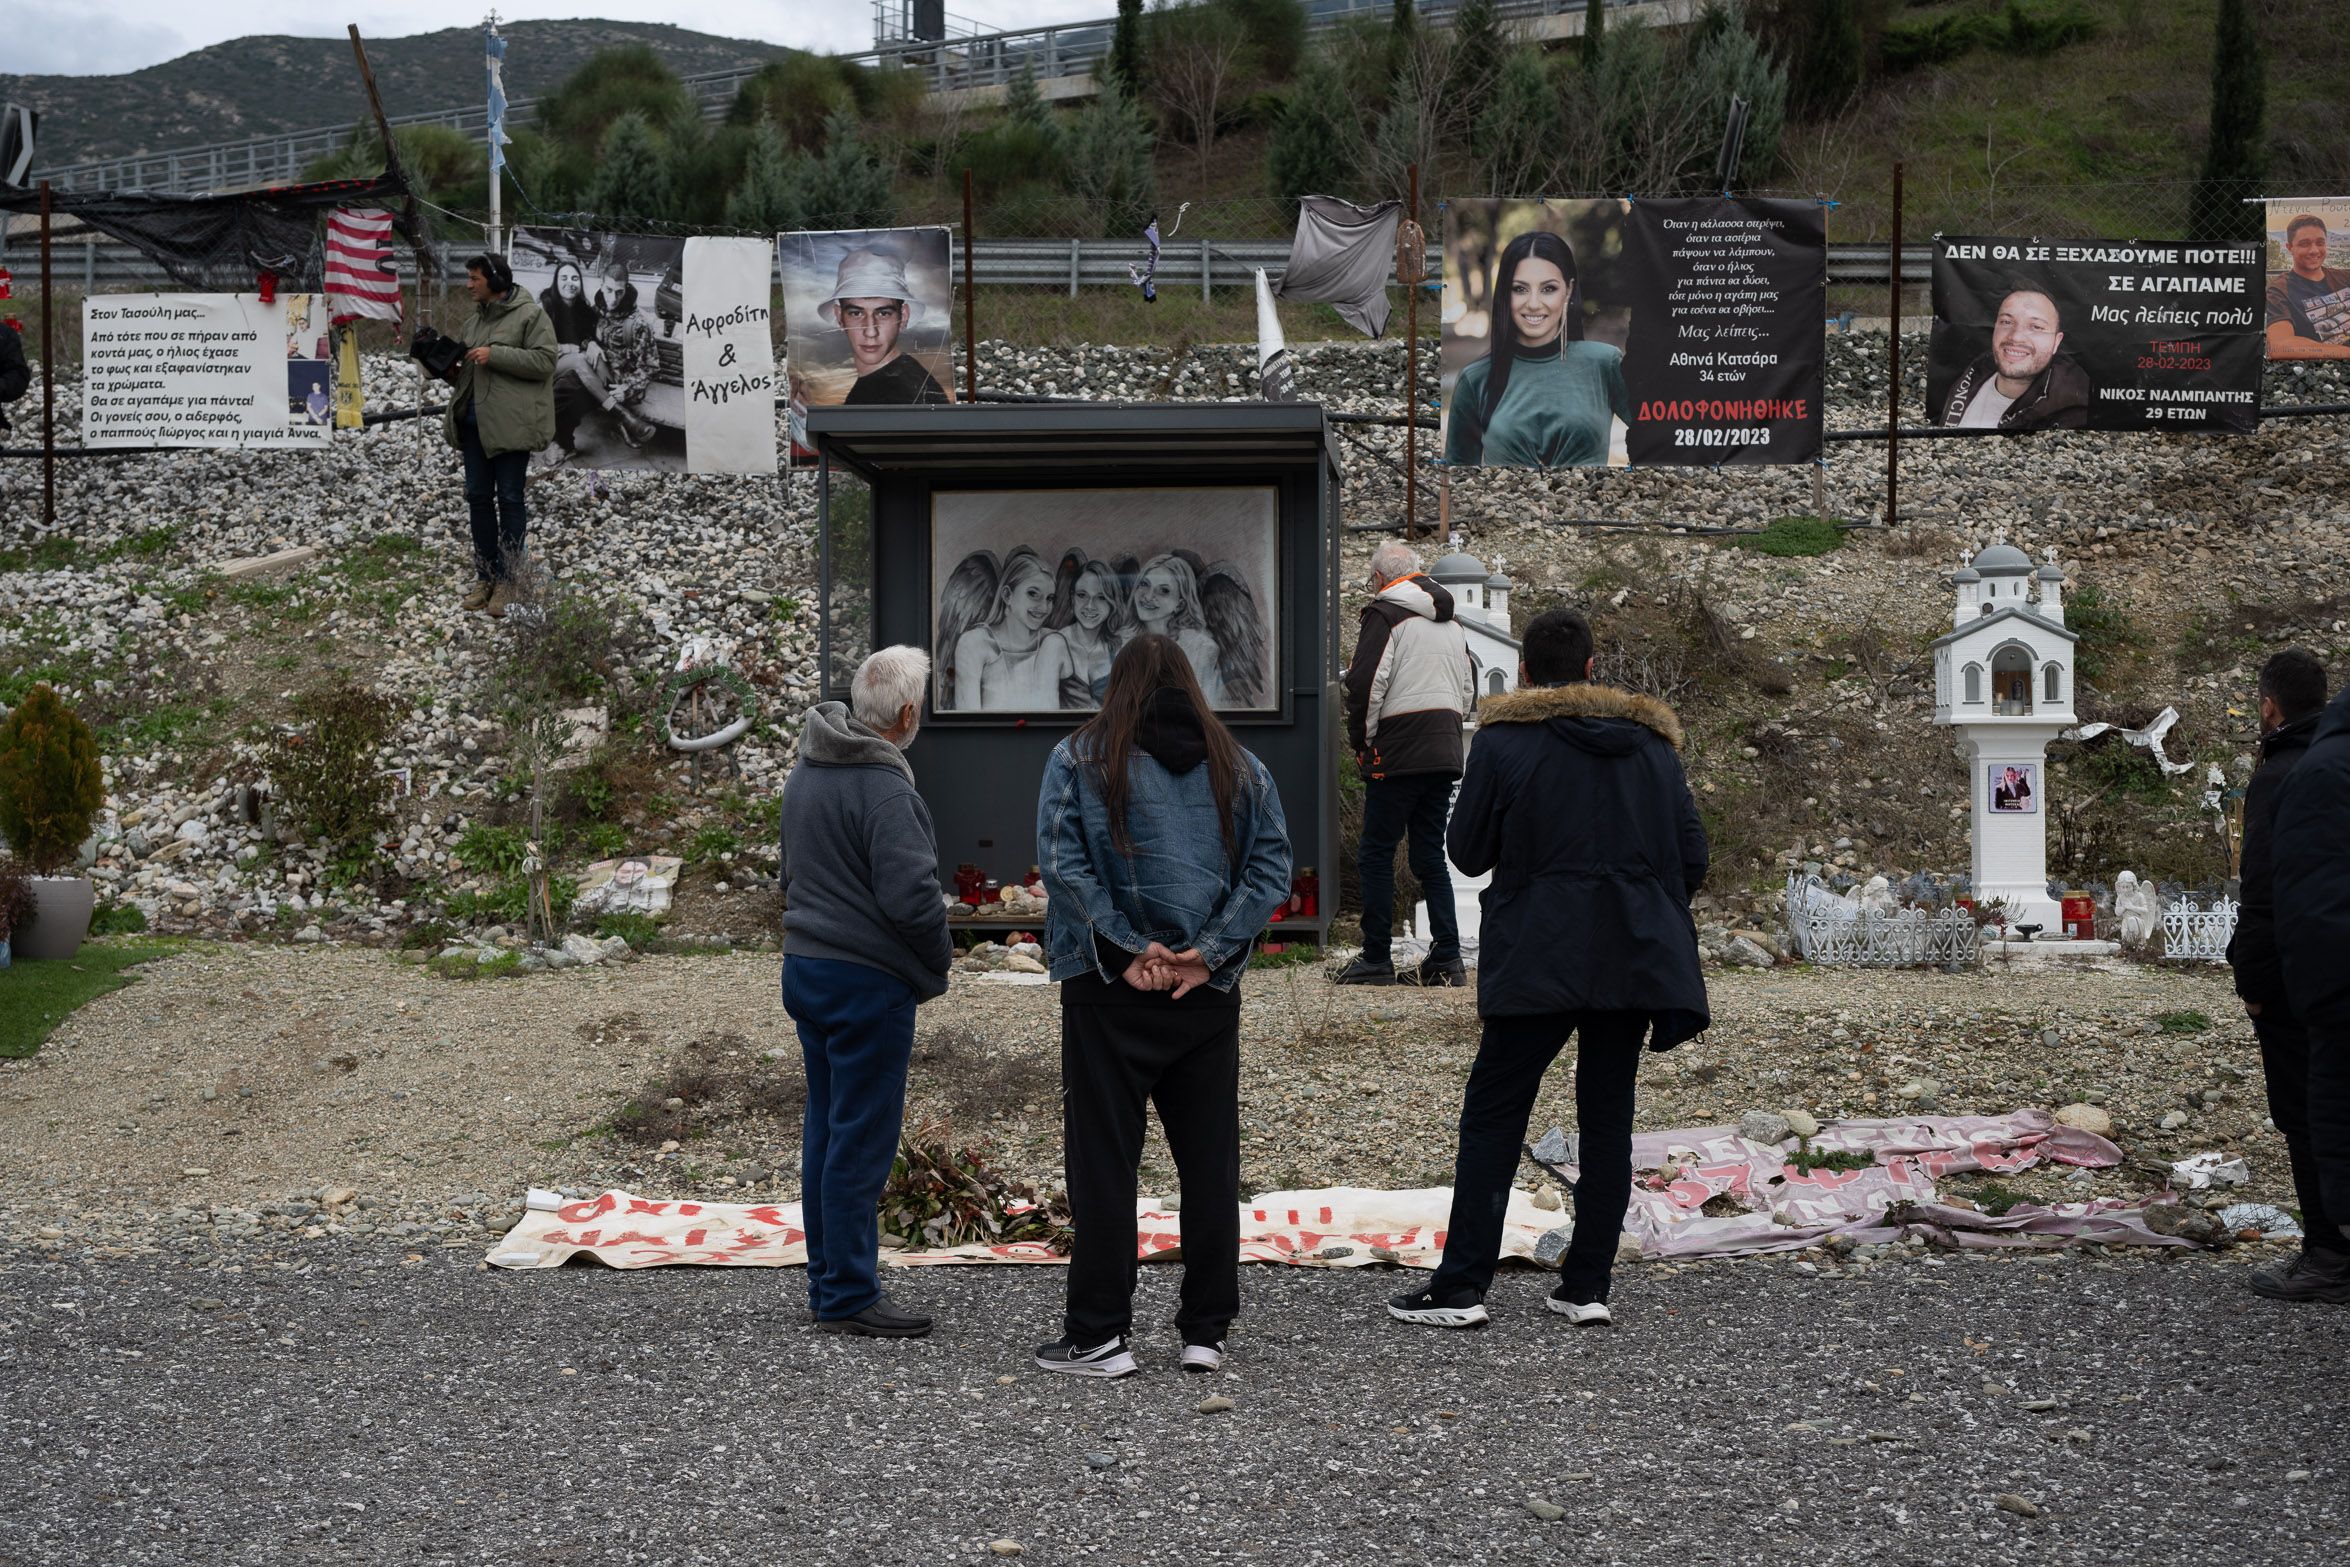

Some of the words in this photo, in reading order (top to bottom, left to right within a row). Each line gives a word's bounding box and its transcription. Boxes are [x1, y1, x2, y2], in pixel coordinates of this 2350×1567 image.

[1664, 219, 1689, 228] Όταν
[1692, 222, 1698, 231] η
[1700, 219, 1744, 228] θάλασσα
[1686, 233, 1709, 242] όταν
[1725, 232, 1761, 244] αστέρια
[1673, 248, 1711, 259] πάψουν
[1729, 247, 1774, 258] λάμπουν,
[1945, 245, 1985, 259] ΔΕΝ
[1993, 246, 2020, 260] ΘΑ
[2026, 247, 2050, 260] ΣΕ
[2056, 248, 2178, 263] ΞΕΧΑΣΟΥΜΕ
[2185, 250, 2255, 264] ΠΟΤΕ!!!
[1693, 262, 1716, 271] όταν
[1727, 261, 1754, 273] ήλιος
[1678, 279, 1693, 288] για
[1697, 276, 1725, 285] πάντα
[1743, 275, 1769, 285] δύσει,
[2109, 276, 2134, 291] ΣΕ
[2141, 277, 2245, 293] ΑΓΑΠΑΜΕ
[1669, 291, 1686, 300] τότε
[1688, 290, 1713, 302] μόνο
[1715, 293, 1721, 302] η
[1724, 290, 1757, 302] αγάπη
[1759, 292, 1779, 301] μας
[91, 309, 117, 319] Στον
[121, 306, 171, 320] Τασούλη
[174, 310, 205, 320] μας...
[1672, 308, 1687, 317] για
[1690, 305, 1716, 314] εσένα
[2091, 305, 2129, 325] Μας
[2135, 306, 2200, 326] λείπεις
[2206, 308, 2252, 324] πολύ
[687, 305, 769, 338] Αφροδίτη
[91, 332, 113, 342] Από
[117, 331, 141, 341] τότε
[145, 332, 167, 340] που
[189, 330, 228, 343] πήραν
[232, 331, 257, 341] από
[1678, 325, 1710, 341] Μας
[1715, 324, 1769, 340] λείπεις...
[91, 348, 125, 358] κοντά
[128, 349, 153, 360] μας,
[167, 346, 199, 359] ήλιος
[203, 347, 238, 359] έχασε
[2150, 340, 2200, 353] ΤΕΜΠΗ
[719, 344, 736, 367] &
[1670, 352, 1713, 365] Αθηνά
[1718, 352, 1777, 367] Κατσάρα
[2138, 354, 2211, 370] 28-02-2023
[107, 366, 131, 376] φως
[134, 365, 152, 373] και
[155, 362, 251, 375] εξαφανίστηκαν
[1700, 370, 1714, 381] 34
[1718, 370, 1746, 381] ετών
[108, 381, 165, 392] χρώματα.
[691, 374, 771, 404] Άγγελος
[91, 396, 107, 406] Θα
[127, 395, 184, 408] αγαπάμε
[188, 397, 206, 408] για
[211, 395, 254, 405] πάντα!
[2100, 389, 2145, 400] ΝΙΚΟΣ
[2150, 390, 2253, 403] ΝΑΛΜΠΑΝΤΗΣ
[1638, 400, 1807, 420] ΔΟΛΟΦΟΝΗΘΗΚΕ
[2146, 408, 2163, 418] 29
[2168, 408, 2206, 419] ΕΤΩΝ
[91, 412, 102, 422] Οι
[106, 411, 142, 424] γονείς
[145, 413, 171, 423] σου,
[175, 413, 182, 421] ο
[186, 411, 242, 424] αδερφός,
[90, 430, 97, 438] ο
[101, 429, 156, 439] παππούς
[159, 426, 205, 440] Γιώργος
[231, 430, 239, 440] η
[243, 428, 283, 441] γιαγιά
[288, 427, 321, 438] Άννα.
[1675, 428, 1770, 446] 28/02/2023
